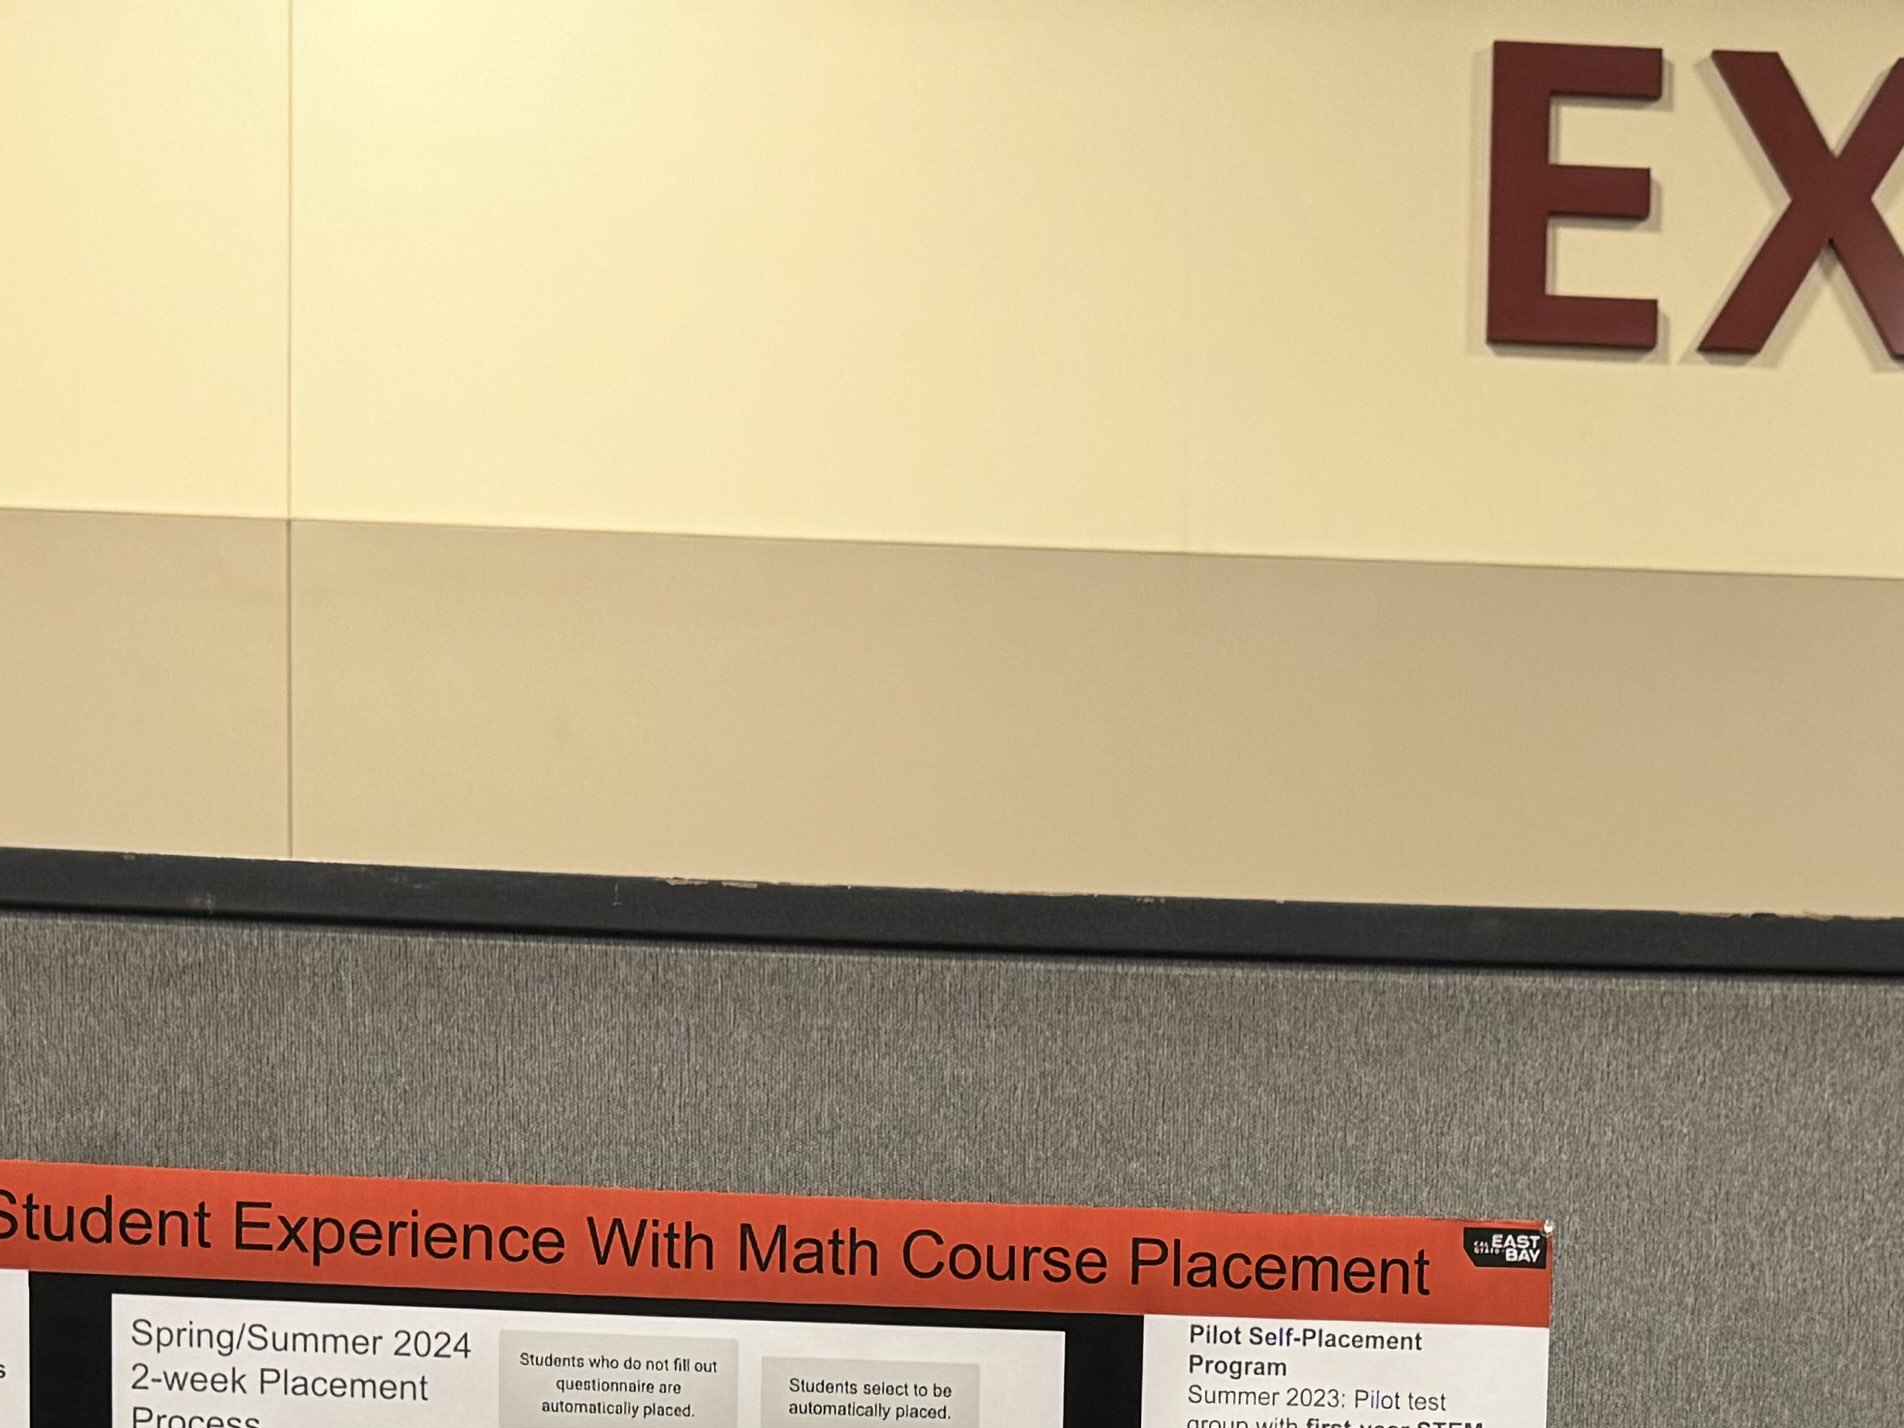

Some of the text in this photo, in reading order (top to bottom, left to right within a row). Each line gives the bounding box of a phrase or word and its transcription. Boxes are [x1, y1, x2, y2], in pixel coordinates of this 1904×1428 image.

[236, 1201, 564, 1266] Experience
[588, 1217, 713, 1270] With
[740, 1224, 877, 1276] Math
[903, 1230, 1107, 1284] Course
[1132, 1238, 1430, 1295] Placement
[1491, 1234, 1541, 1249] EAST
[1505, 1248, 1541, 1263] BAY
[132, 1319, 471, 1358] Spring/Summer 2024
[1190, 1324, 1422, 1350] Pilot Self-Placement
[1190, 1354, 1286, 1380] Program
[132, 1363, 428, 1400] 2-week Placement
[1188, 1384, 1446, 1411] Summer 2023: Pilot test
